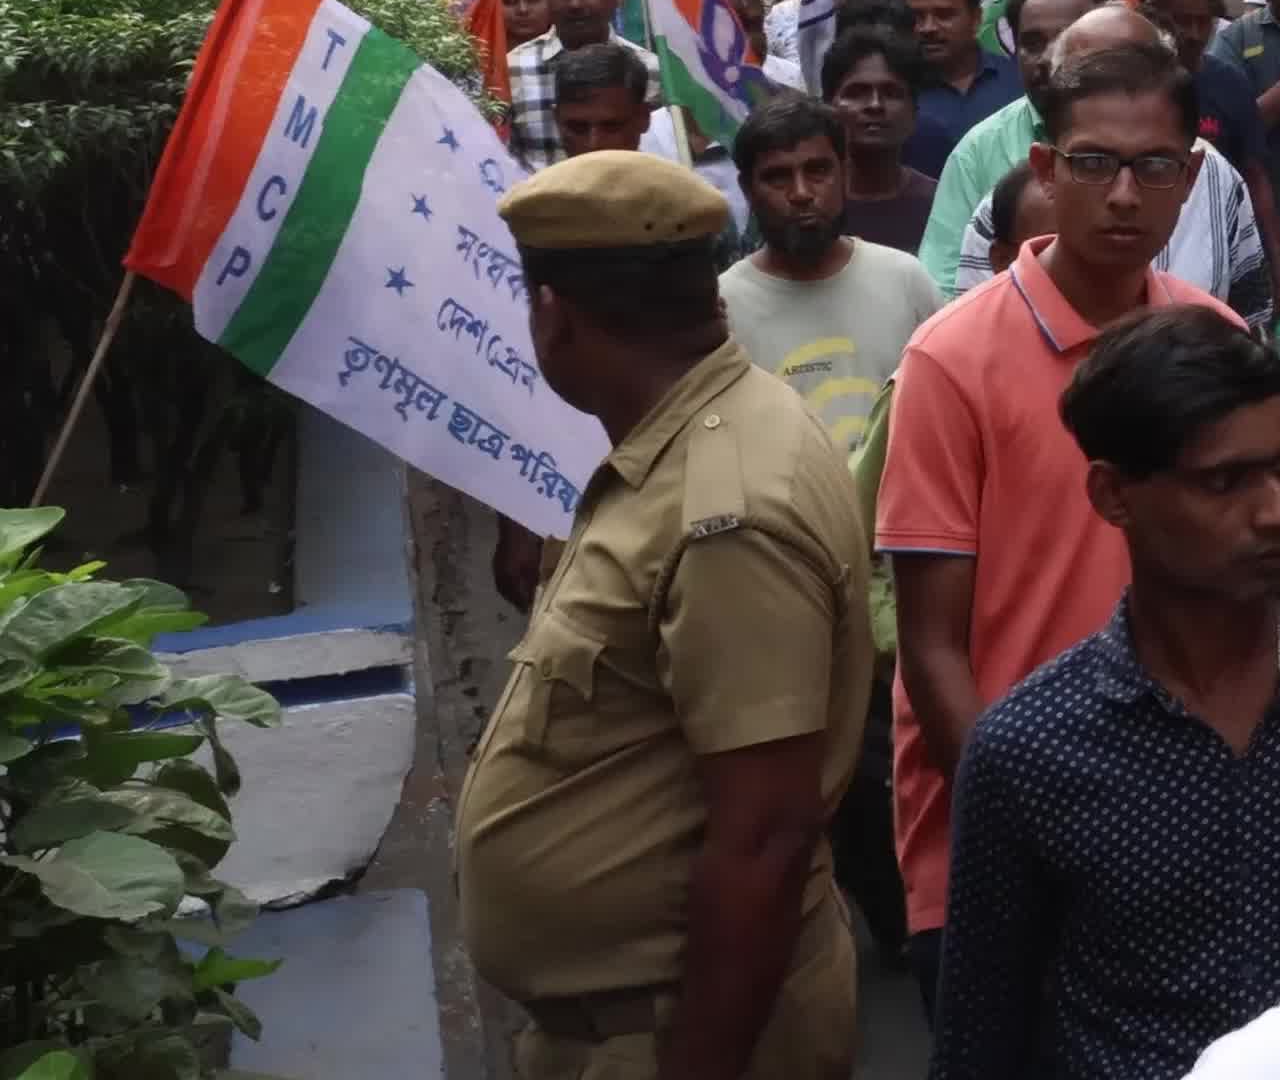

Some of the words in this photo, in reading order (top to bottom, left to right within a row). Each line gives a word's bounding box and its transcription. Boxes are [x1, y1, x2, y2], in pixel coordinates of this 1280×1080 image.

[337, 334, 449, 424] তৃণমূল
[447, 397, 511, 462] ছাত্র
[511, 436, 580, 515] পরিষ
